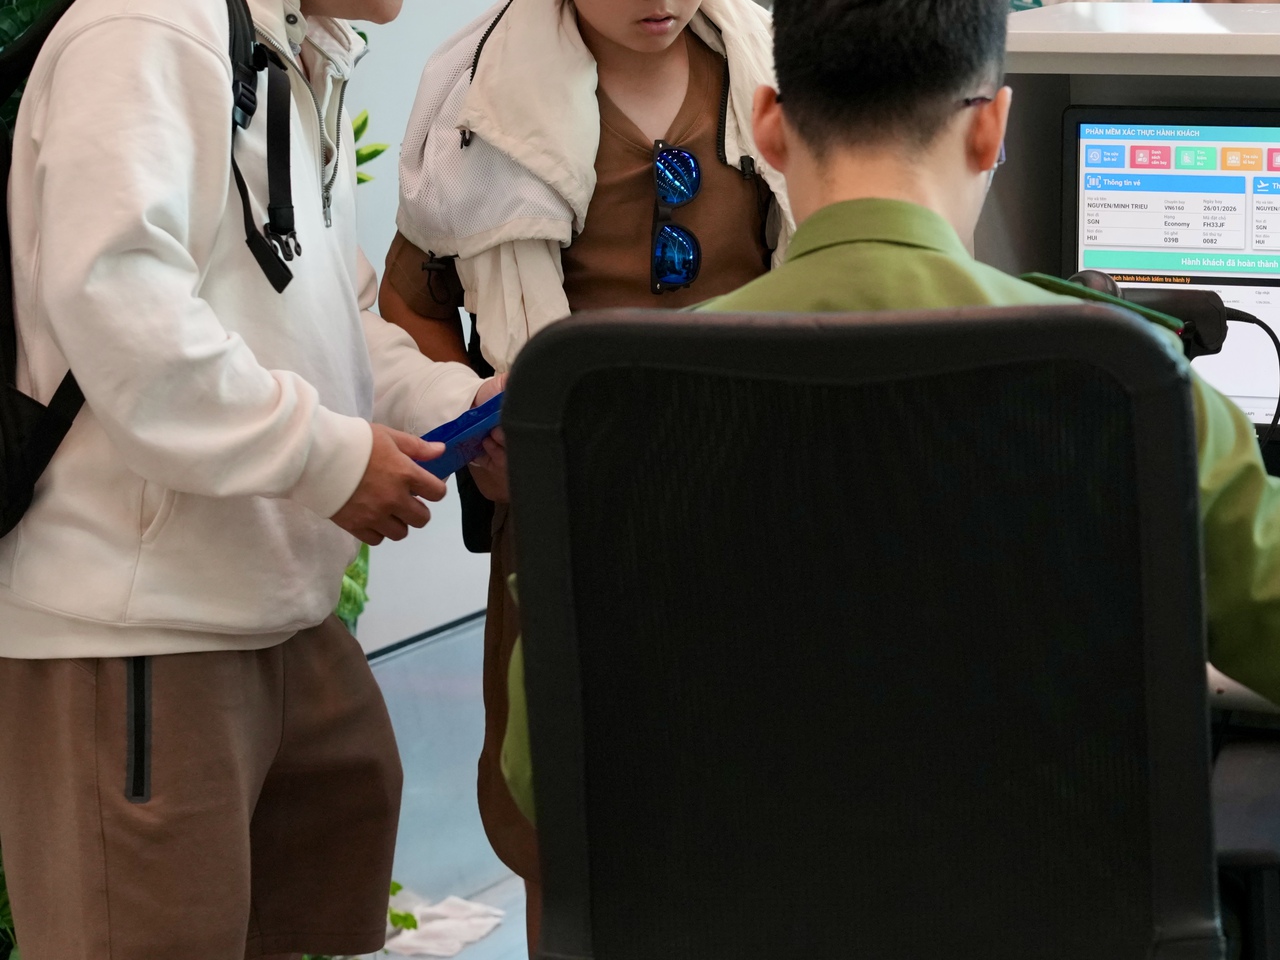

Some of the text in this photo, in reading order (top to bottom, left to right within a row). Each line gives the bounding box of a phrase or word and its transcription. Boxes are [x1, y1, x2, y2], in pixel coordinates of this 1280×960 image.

[1086, 127, 1104, 135] PHẦN
[1106, 128, 1121, 136] MỀM
[1123, 128, 1135, 136] XÁC
[1137, 129, 1155, 137] THỰC
[1177, 129, 1200, 137] KHÁCH
[1104, 179, 1122, 187] Thông
[1181, 258, 1200, 266] Hành
[1202, 258, 1224, 266] khách
[1226, 258, 1235, 267] đã
[1237, 259, 1255, 267] hoàn
[1257, 259, 1278, 268] thành
